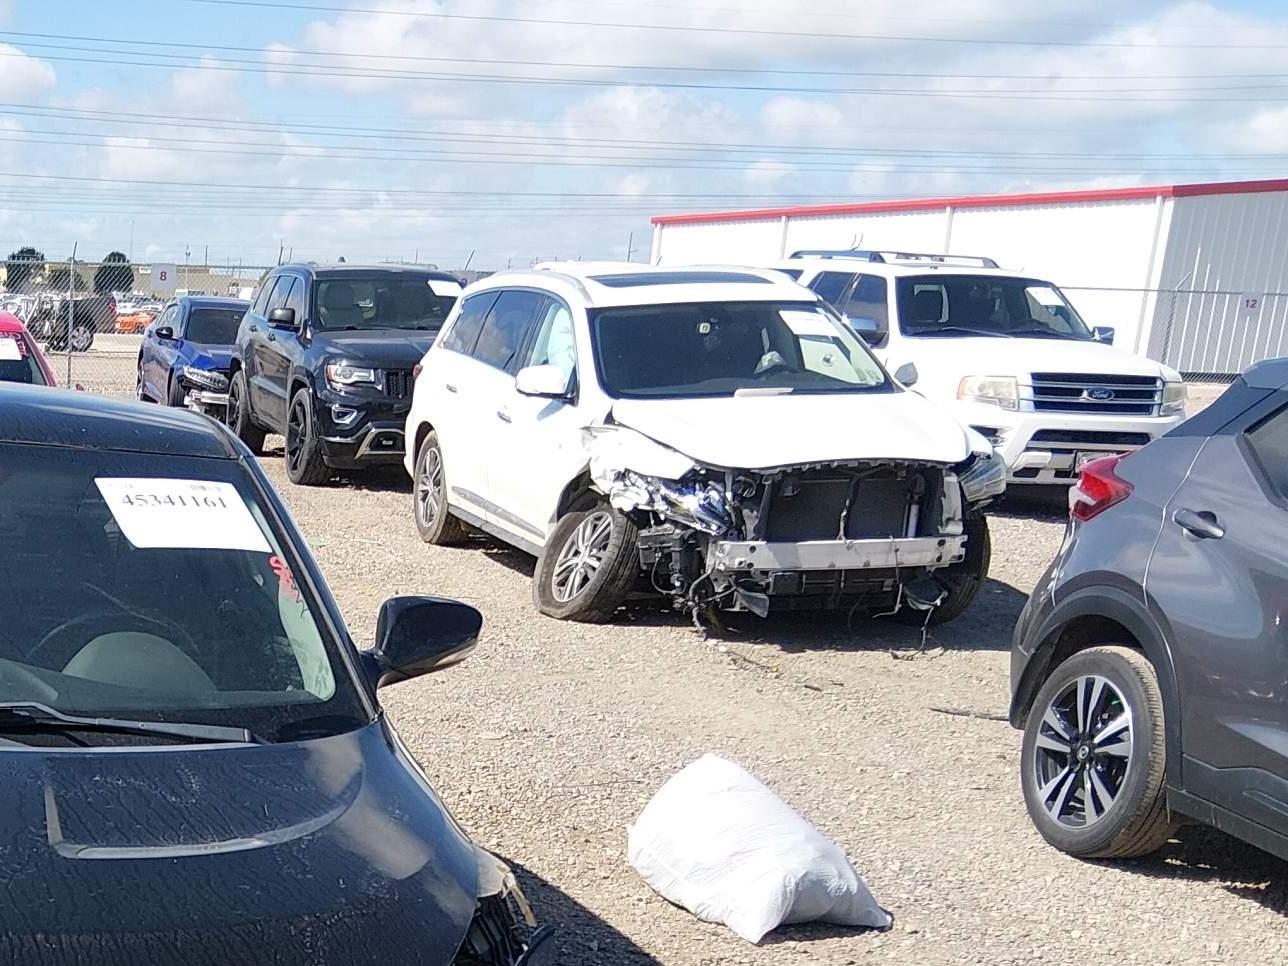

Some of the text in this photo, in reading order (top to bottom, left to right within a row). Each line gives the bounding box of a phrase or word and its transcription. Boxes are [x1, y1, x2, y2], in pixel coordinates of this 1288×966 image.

[159, 271, 168, 281] 8
[1245, 299, 1258, 308] 12
[1091, 390, 1110, 399] Ford
[122, 493, 228, 509] 45341161
